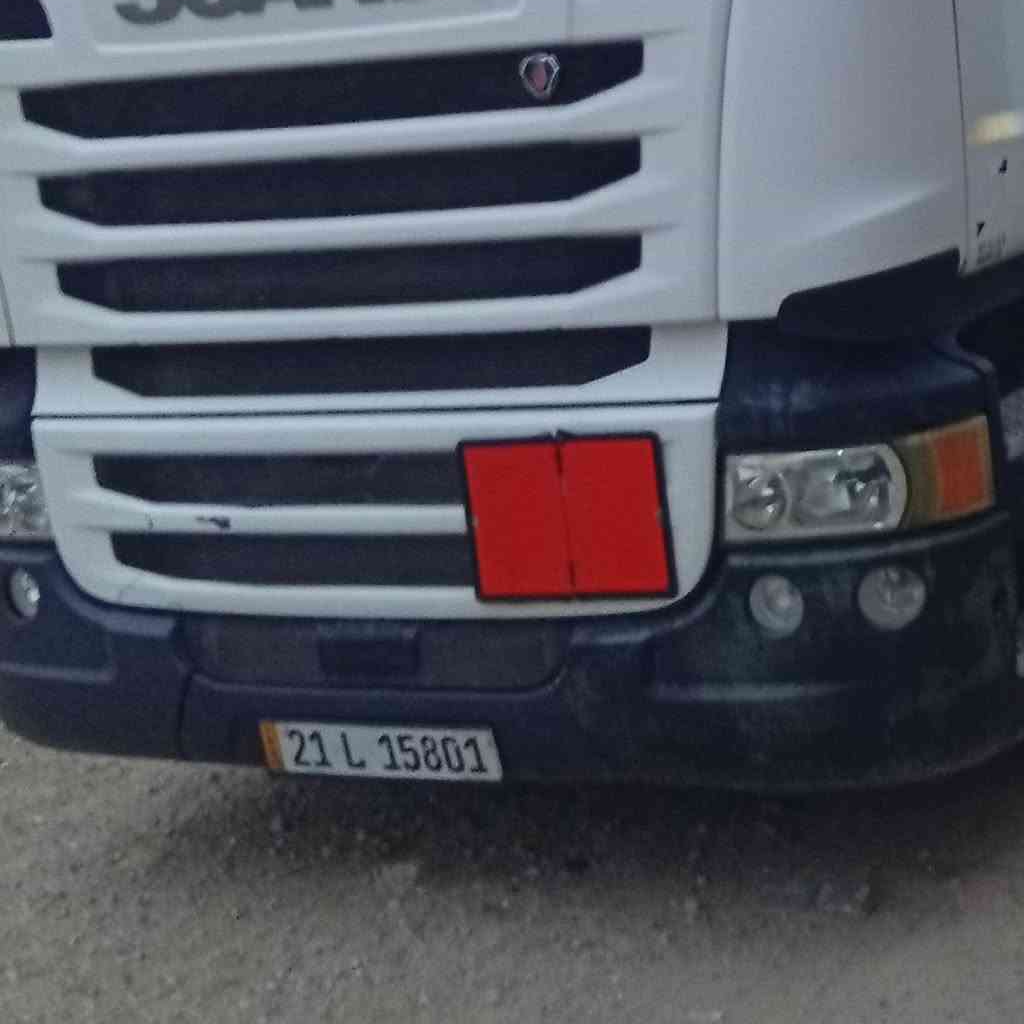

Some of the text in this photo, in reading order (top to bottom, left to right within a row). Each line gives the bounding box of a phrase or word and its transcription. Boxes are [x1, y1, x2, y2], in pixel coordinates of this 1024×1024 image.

[288, 729, 488, 774] 21 L 15801
